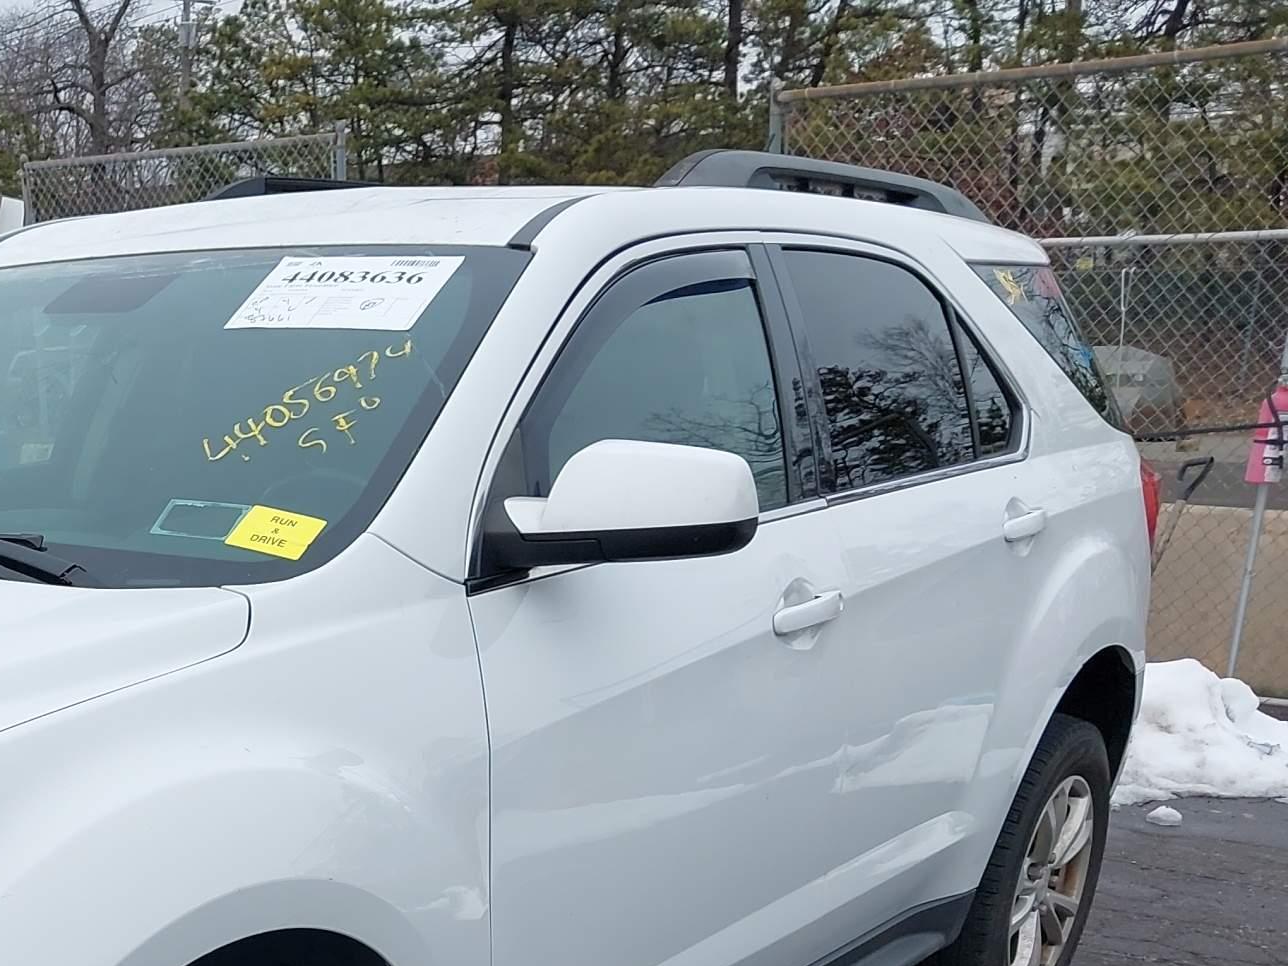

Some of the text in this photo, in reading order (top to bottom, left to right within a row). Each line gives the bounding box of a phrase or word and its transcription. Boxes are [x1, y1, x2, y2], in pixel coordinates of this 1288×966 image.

[281, 270, 426, 285] 44083636
[203, 339, 412, 461] 44056974
[270, 515, 299, 528] RUN
[271, 527, 280, 535] &
[249, 534, 288, 548] DRIVE
